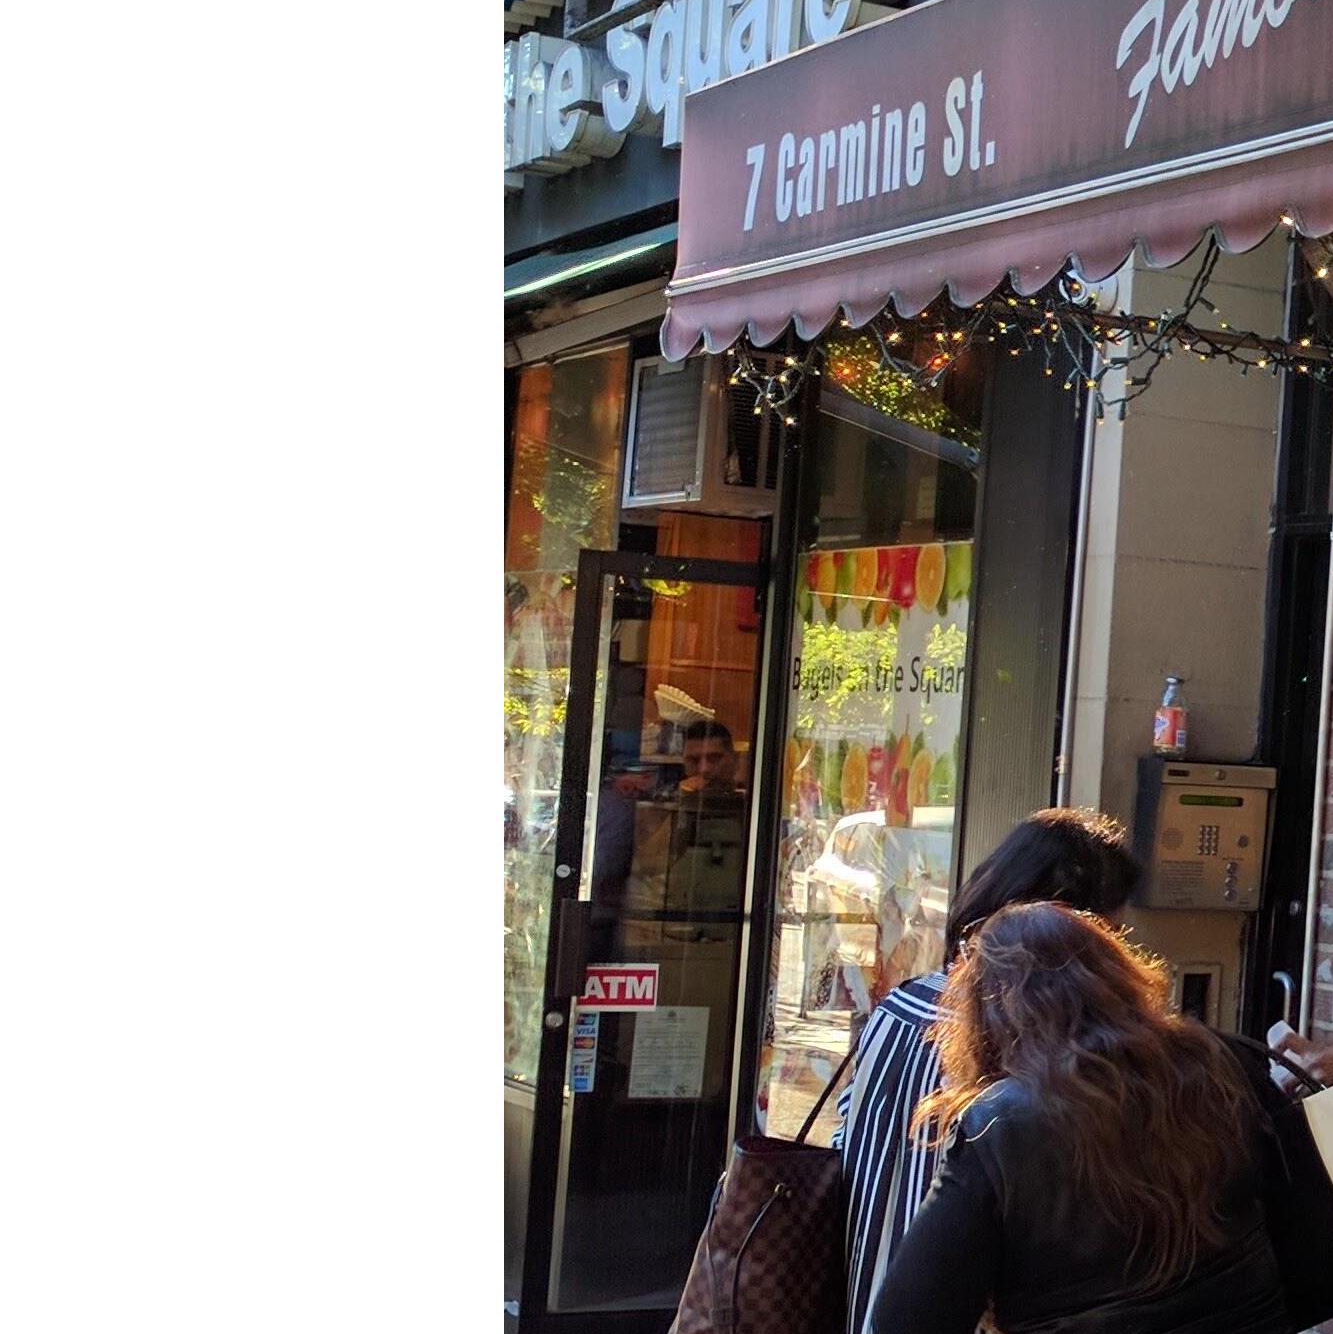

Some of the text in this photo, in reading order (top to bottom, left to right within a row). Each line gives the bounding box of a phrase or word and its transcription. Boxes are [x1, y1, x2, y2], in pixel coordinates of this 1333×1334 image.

[743, 70, 996, 231] 7 Carmine St.
[580, 975, 654, 1000] ATM
[575, 1027, 597, 1035] VISA
